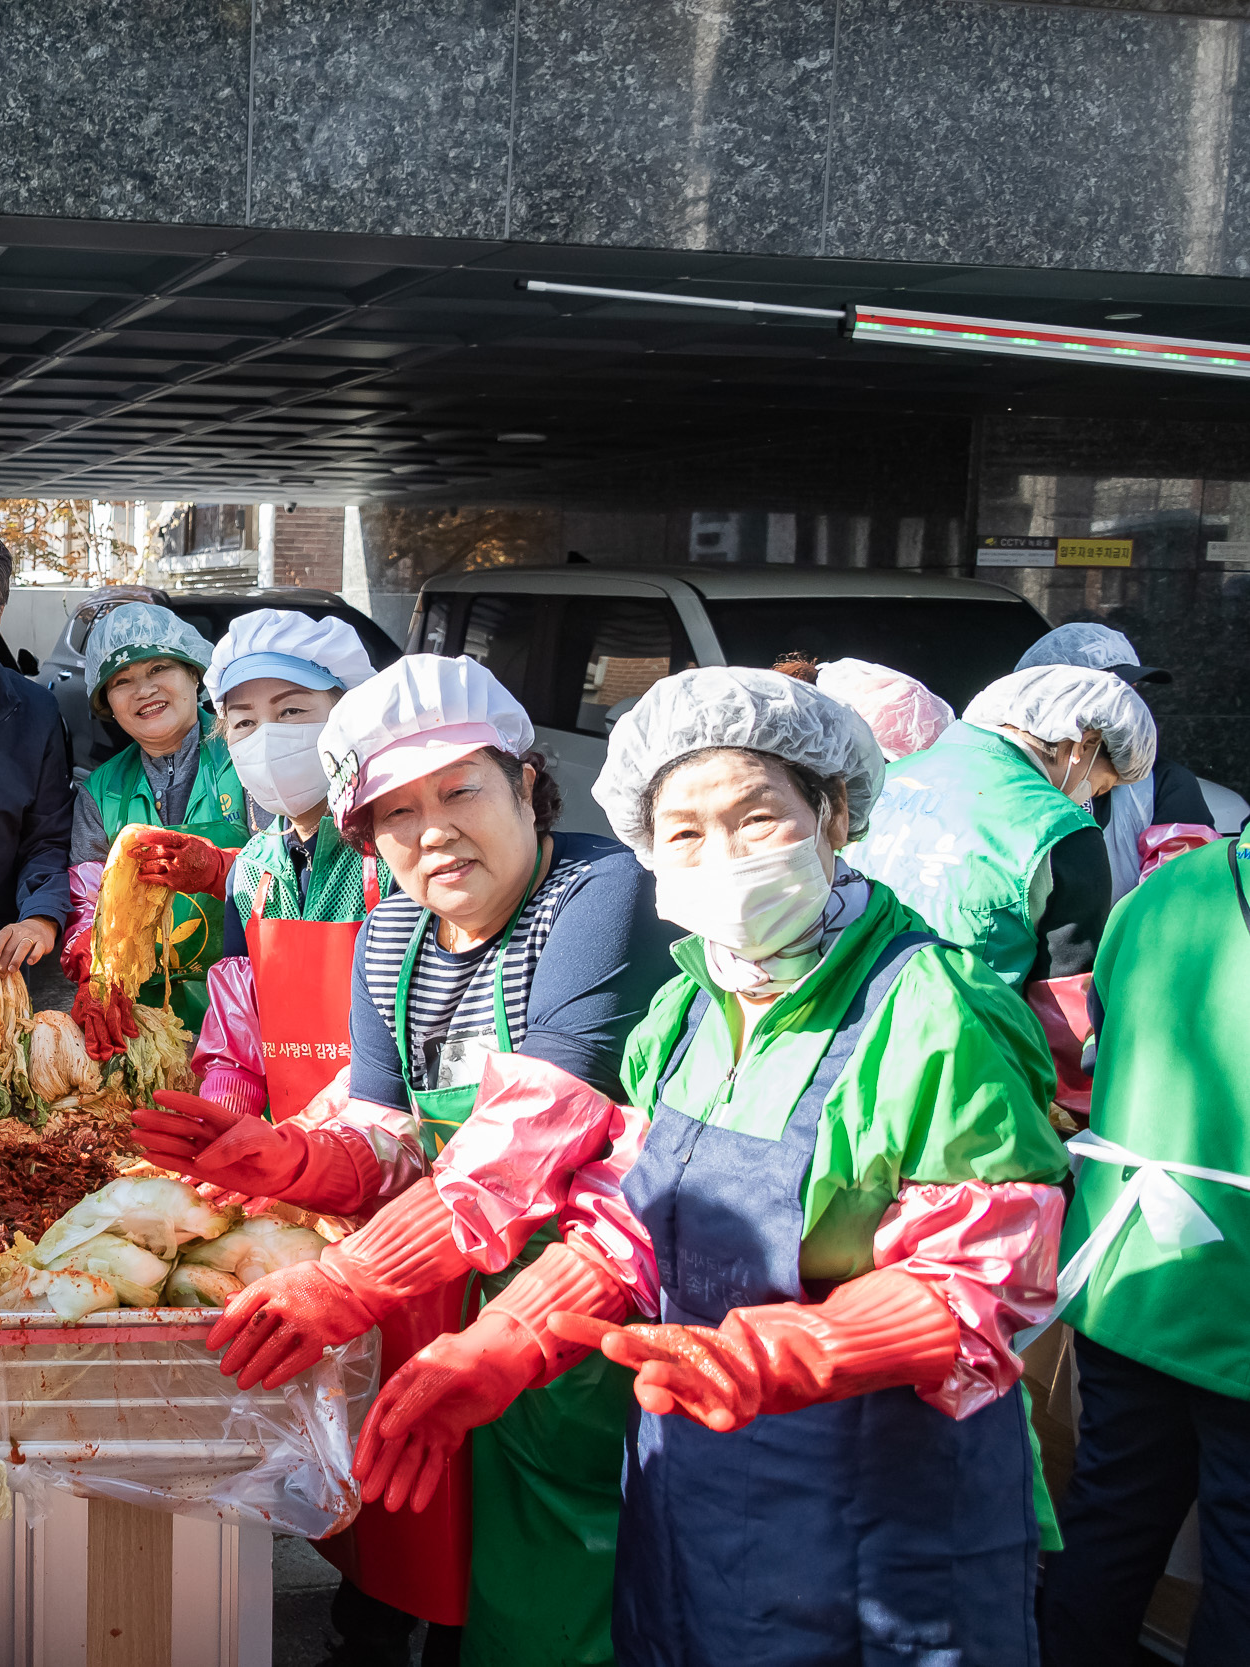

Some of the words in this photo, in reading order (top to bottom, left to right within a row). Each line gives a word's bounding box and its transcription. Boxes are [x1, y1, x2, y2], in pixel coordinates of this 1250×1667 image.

[1000, 538, 1026, 547] CCTV
[845, 823, 961, 888] 마을
[279, 1042, 313, 1059] 사랑의
